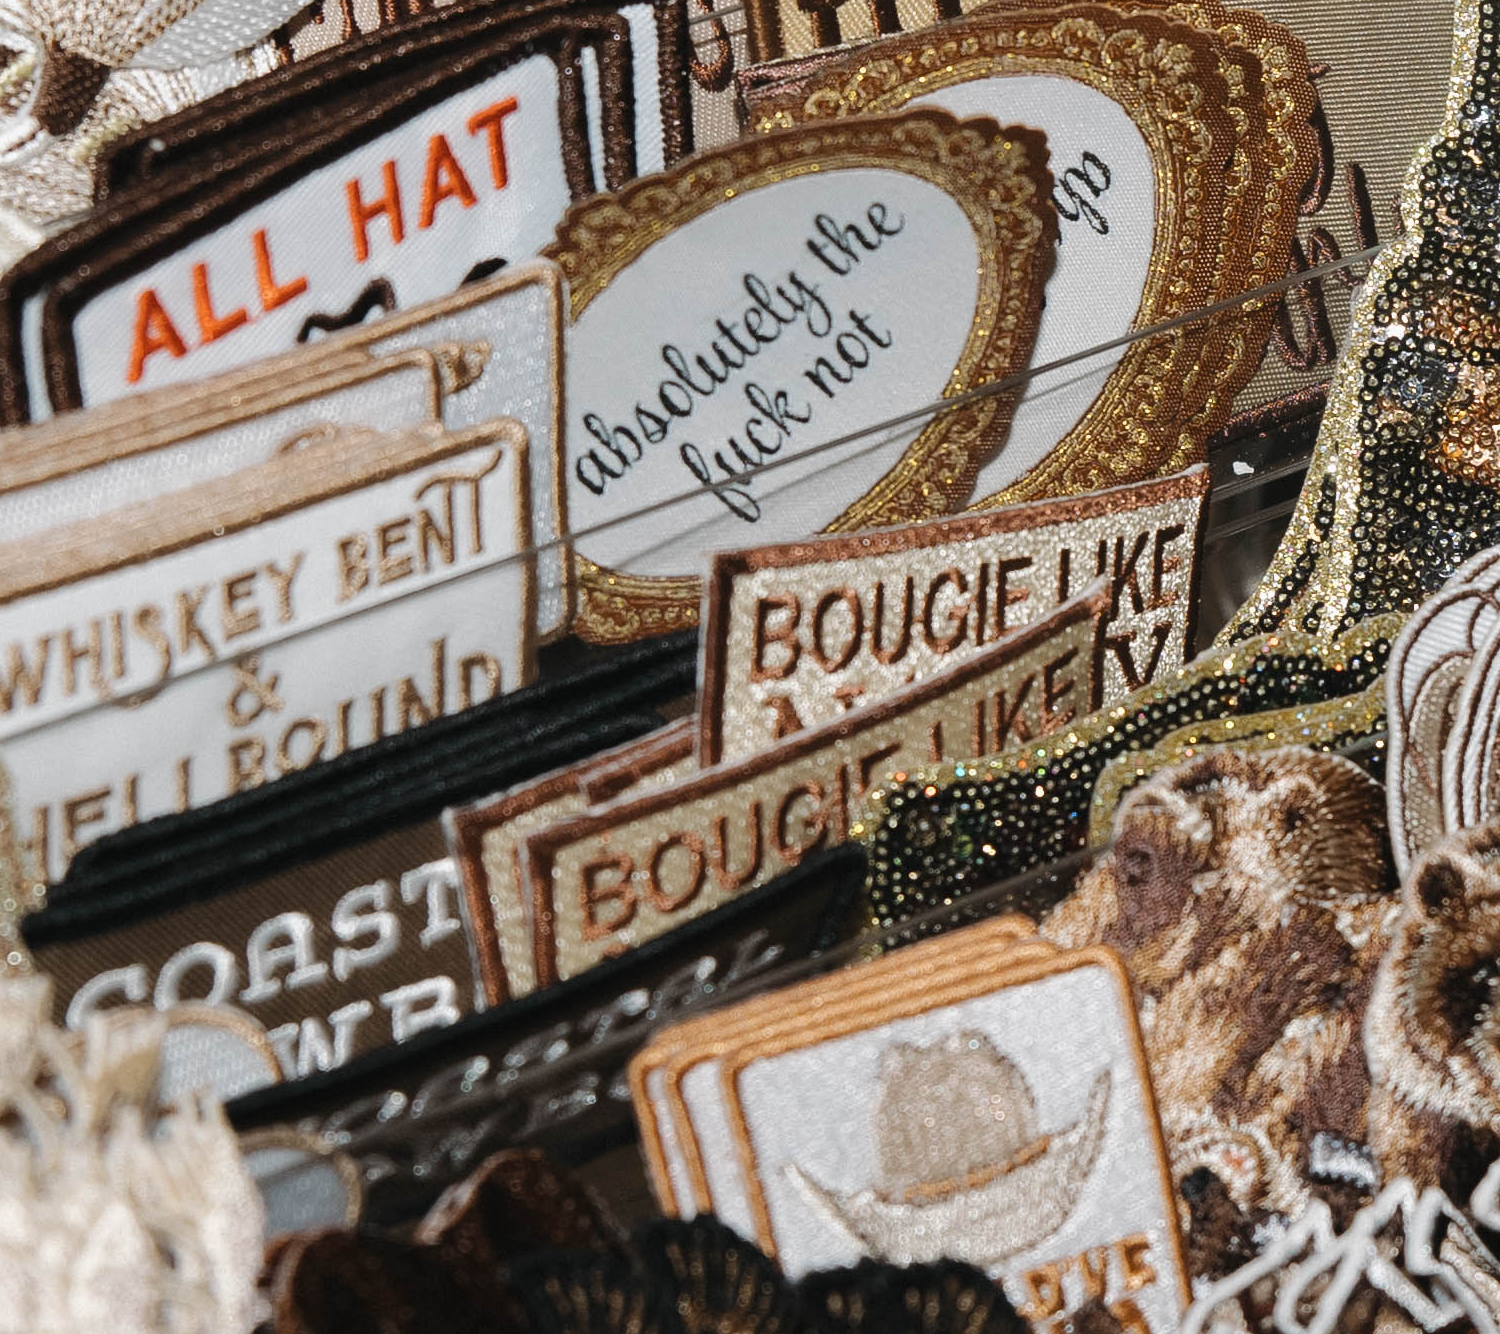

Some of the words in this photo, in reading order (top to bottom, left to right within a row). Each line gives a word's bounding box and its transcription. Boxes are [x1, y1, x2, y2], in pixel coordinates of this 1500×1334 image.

[126, 228, 308, 384] ALL
[345, 96, 519, 263] HAT
[573, 269, 837, 497] absolutely
[813, 198, 906, 303] the
[680, 380, 813, 524] fuck
[813, 307, 894, 400] not
[335, 449, 503, 604] BENT
[749, 554, 1033, 681] BOUGIE
[1058, 523, 1186, 623] LIKE
[224, 651, 288, 729] &
